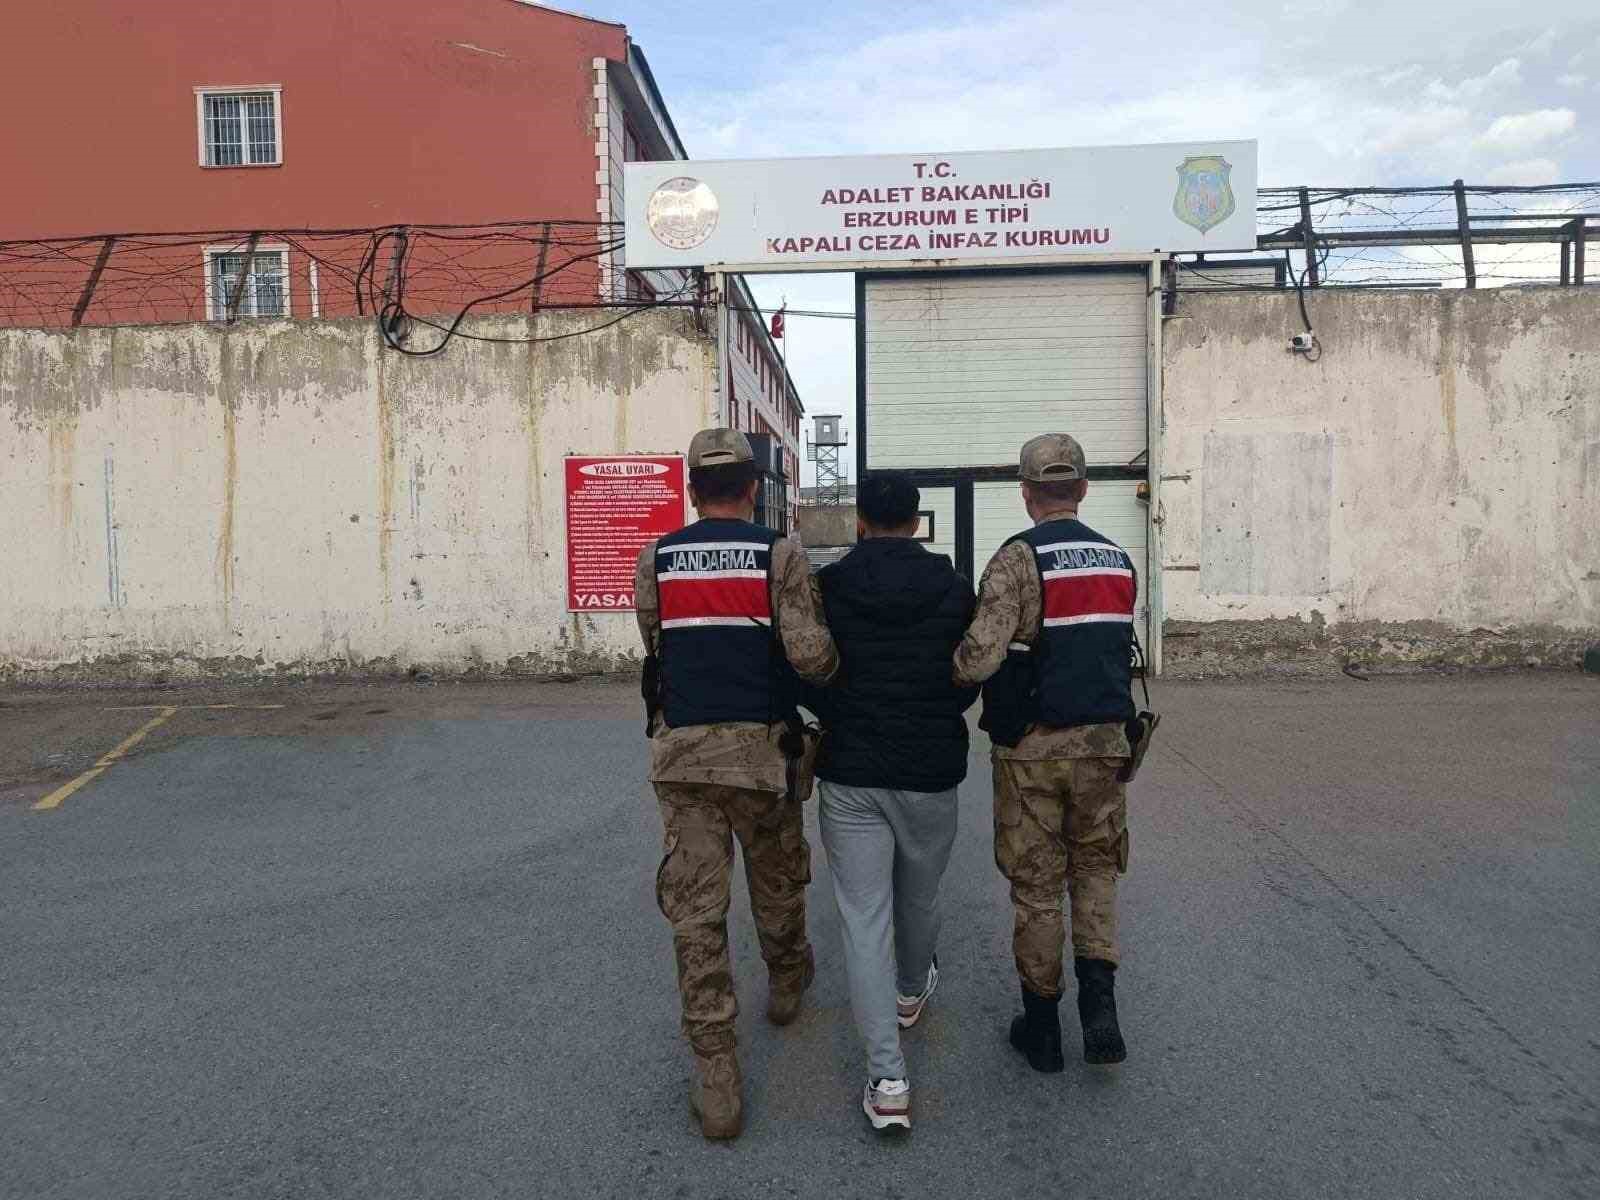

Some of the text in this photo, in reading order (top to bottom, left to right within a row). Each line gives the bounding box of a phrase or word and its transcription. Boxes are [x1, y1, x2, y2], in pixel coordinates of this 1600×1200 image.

[913, 162, 957, 178] T.C.
[821, 179, 1051, 205] ADALET BAKANLIĞI
[844, 203, 1029, 228] ERZURUM E TİPİ
[767, 228, 1110, 253] KAPALI CEZA İNFAZ KURUMU
[594, 464, 655, 475] YASAL UYARI
[667, 550, 757, 571] JANDARMA
[1053, 549, 1126, 569] JANDARMA
